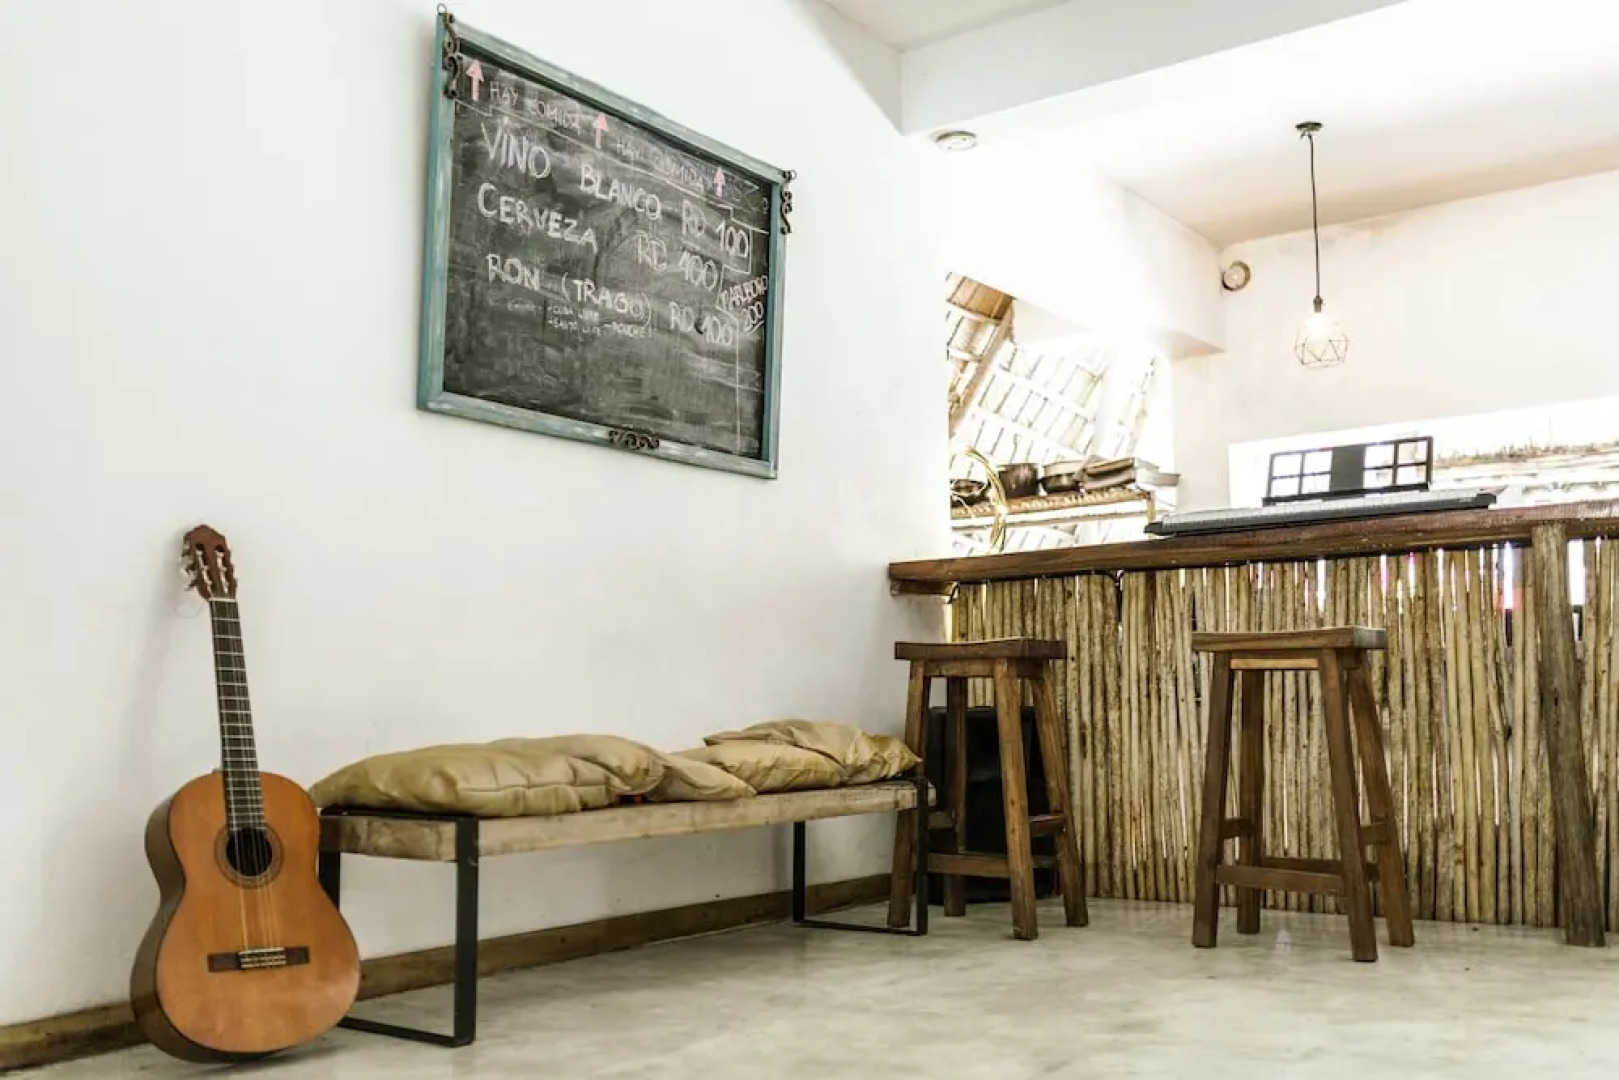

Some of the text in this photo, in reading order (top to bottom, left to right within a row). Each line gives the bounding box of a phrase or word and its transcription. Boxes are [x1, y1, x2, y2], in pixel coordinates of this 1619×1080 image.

[477, 182, 598, 254] CERVEZA
[579, 163, 662, 221] BLANCO
[716, 219, 749, 259] 100
[486, 252, 540, 291] RON
[669, 300, 696, 333] RD
[702, 314, 733, 346] 100
